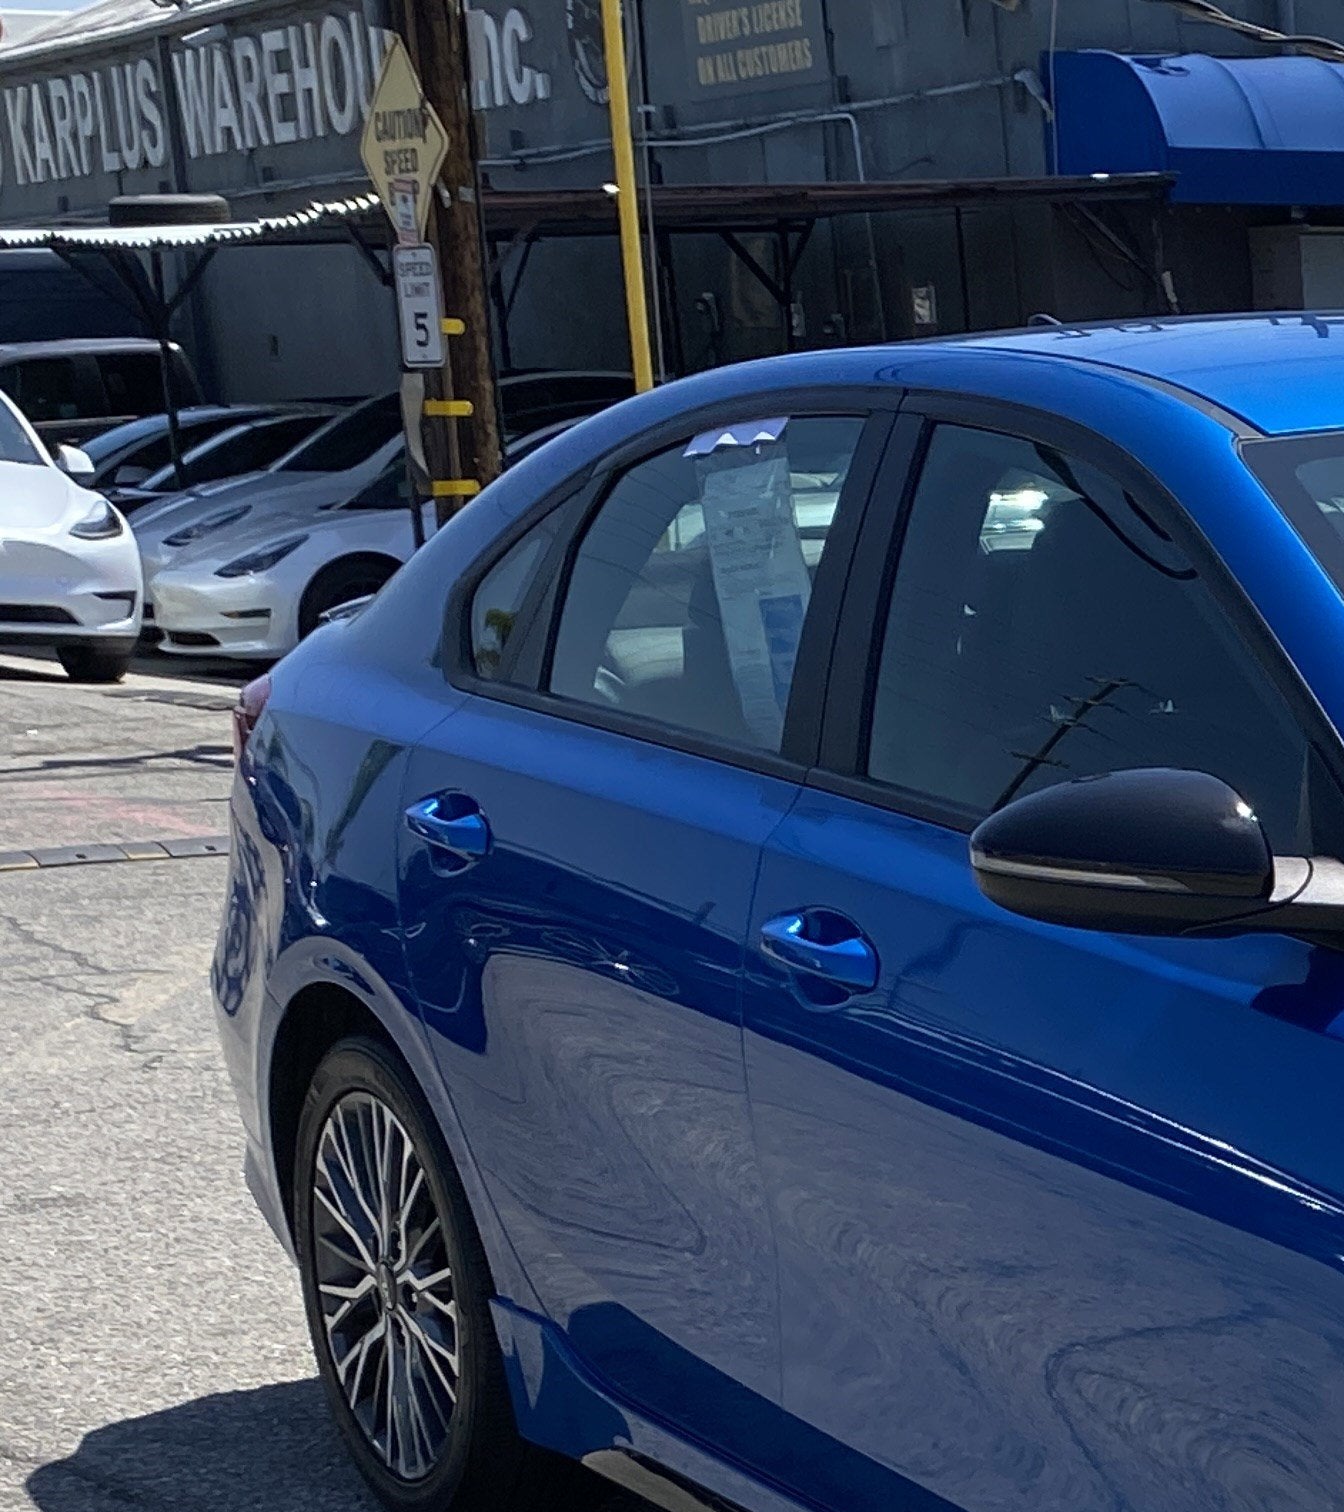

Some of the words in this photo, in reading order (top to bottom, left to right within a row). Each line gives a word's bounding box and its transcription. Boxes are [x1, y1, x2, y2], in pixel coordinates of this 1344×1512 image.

[5, 59, 166, 185] KARPLUS
[399, 261, 432, 277] SPEED
[414, 312, 429, 347] 5
